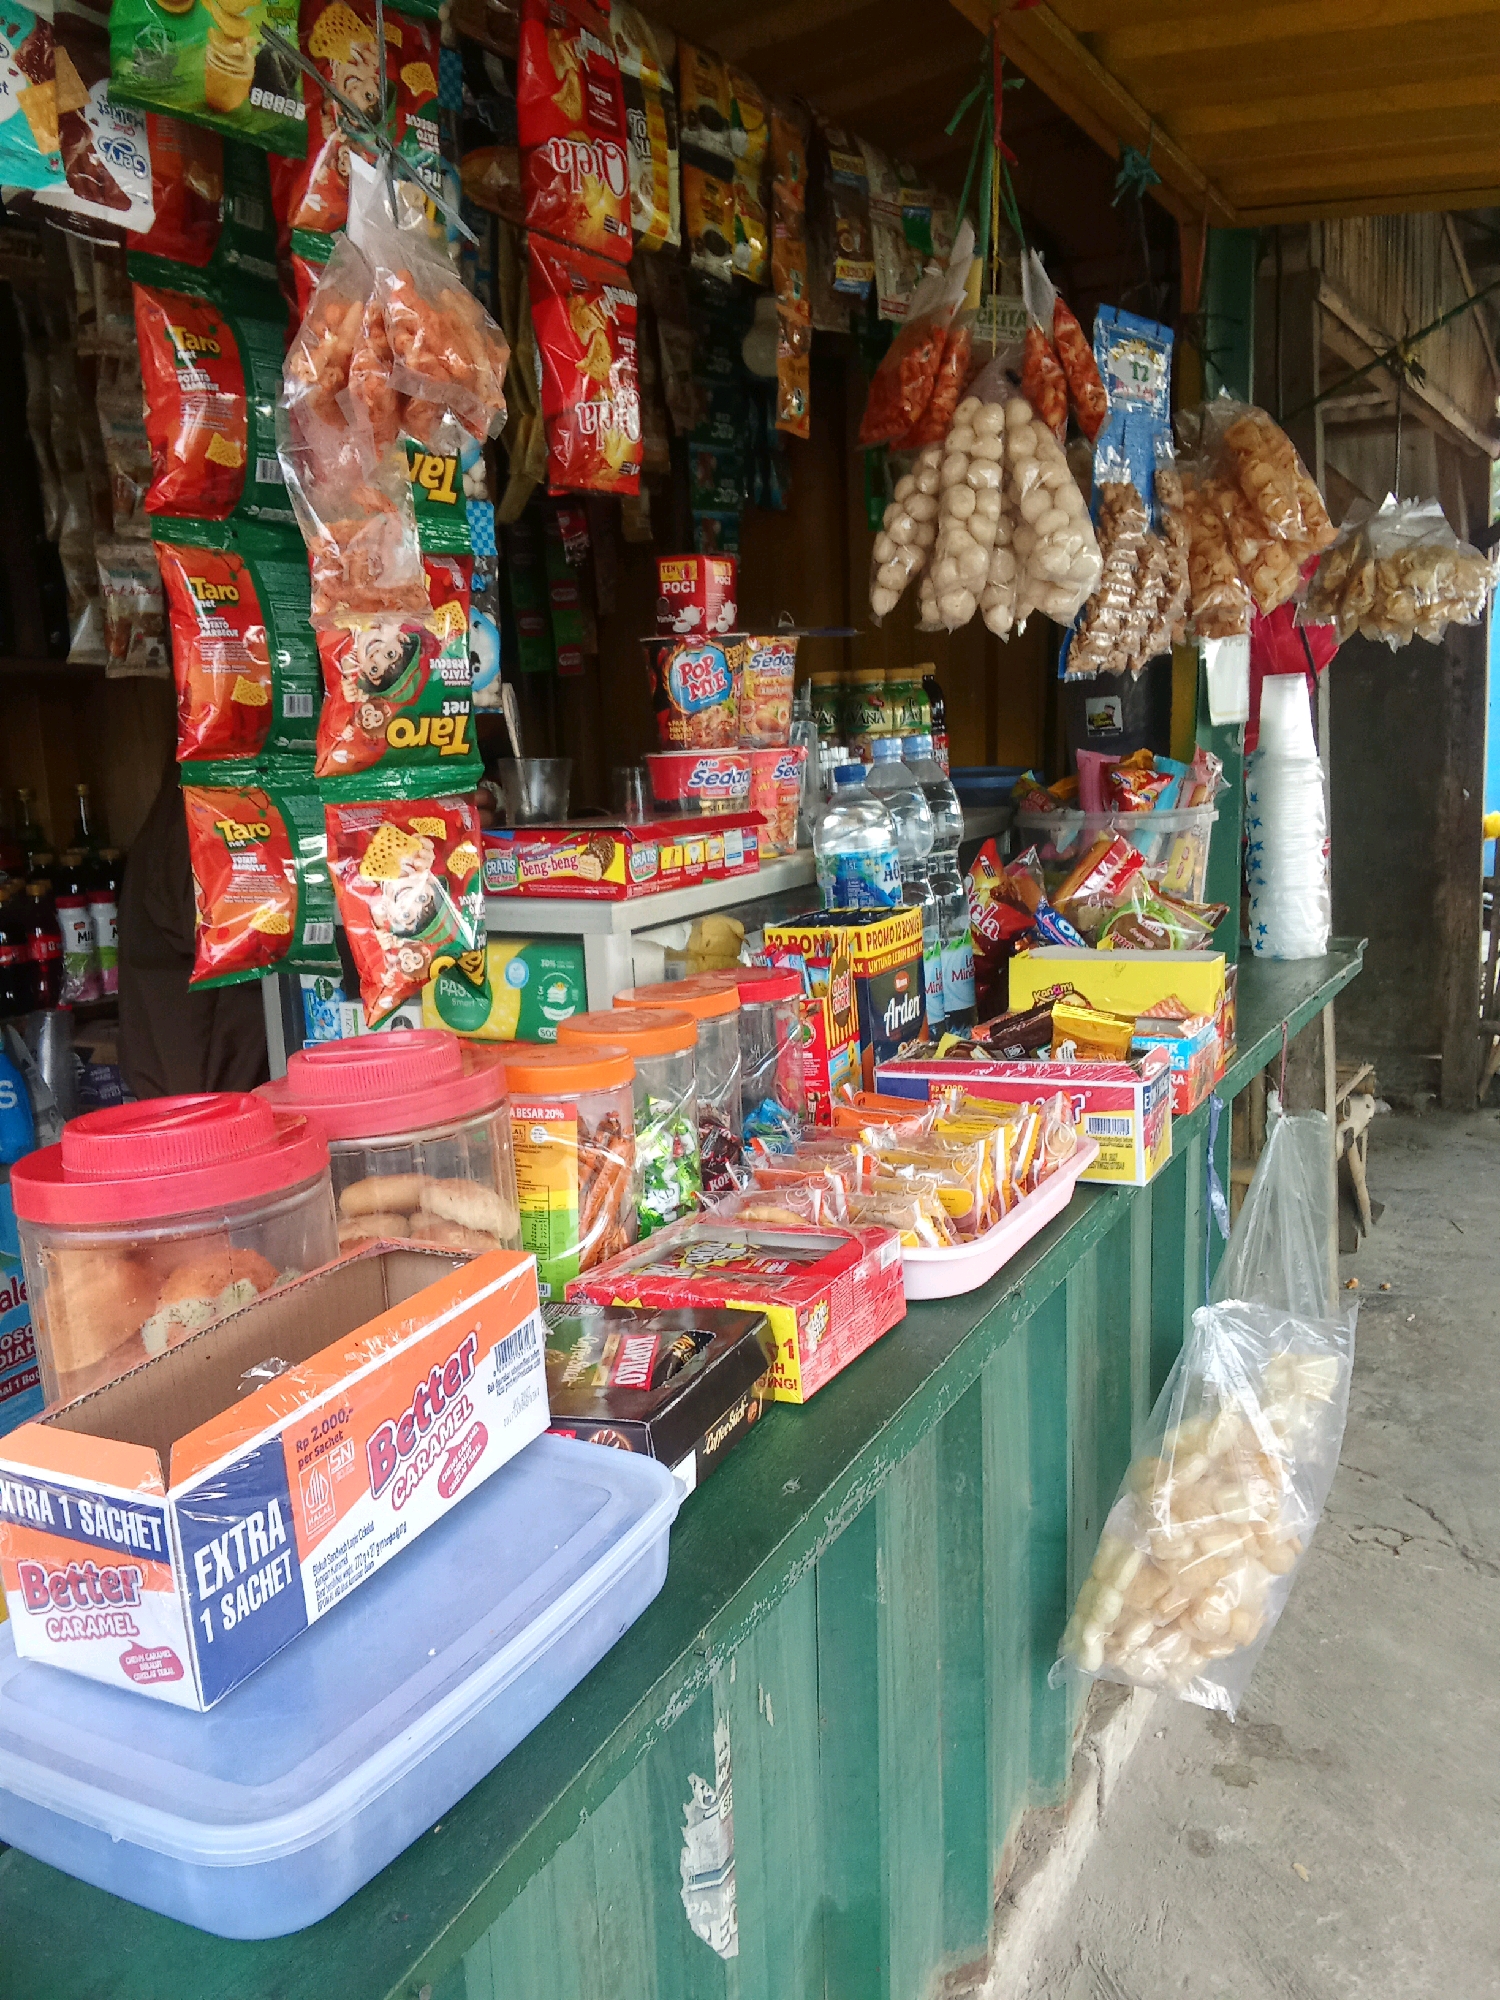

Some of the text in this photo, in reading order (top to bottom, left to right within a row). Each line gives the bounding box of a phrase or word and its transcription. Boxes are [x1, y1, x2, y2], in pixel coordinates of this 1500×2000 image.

[550, 137, 629, 199] Qtela
[172, 325, 221, 353] Taro
[405, 454, 459, 506] Tar
[189, 577, 240, 602] Taro
[662, 580, 696, 595] POCI
[679, 654, 715, 687] POP
[688, 668, 728, 703] MIE
[442, 700, 470, 716] net
[386, 715, 470, 756] Taro
[215, 818, 271, 842] Taro
[486, 860, 516, 875] GRATIS
[521, 854, 579, 877] beng-beng
[866, 924, 894, 953] PROMO
[868, 956, 892, 974] UNTUNG
[884, 993, 921, 1037] Arden
[516, 1108, 544, 1119] BESAR
[544, 1108, 565, 1119] 20%
[614, 1335, 657, 1385] KOPIKO
[366, 1330, 478, 1500] Better
[296, 1437, 309, 1453] Rp
[330, 1441, 355, 1470] SNI
[392, 1394, 474, 1511] CARAMEL
[298, 1451, 314, 1469] per
[0, 1478, 163, 1553] XTRA 1 SACHET
[308, 1506, 332, 1526] HALAL
[193, 1497, 287, 1602] EXTRA
[17, 1559, 144, 1615] Better
[199, 1607, 214, 1644] 1
[220, 1547, 293, 1631] SACHET
[46, 1613, 141, 1642] CARAMEL
